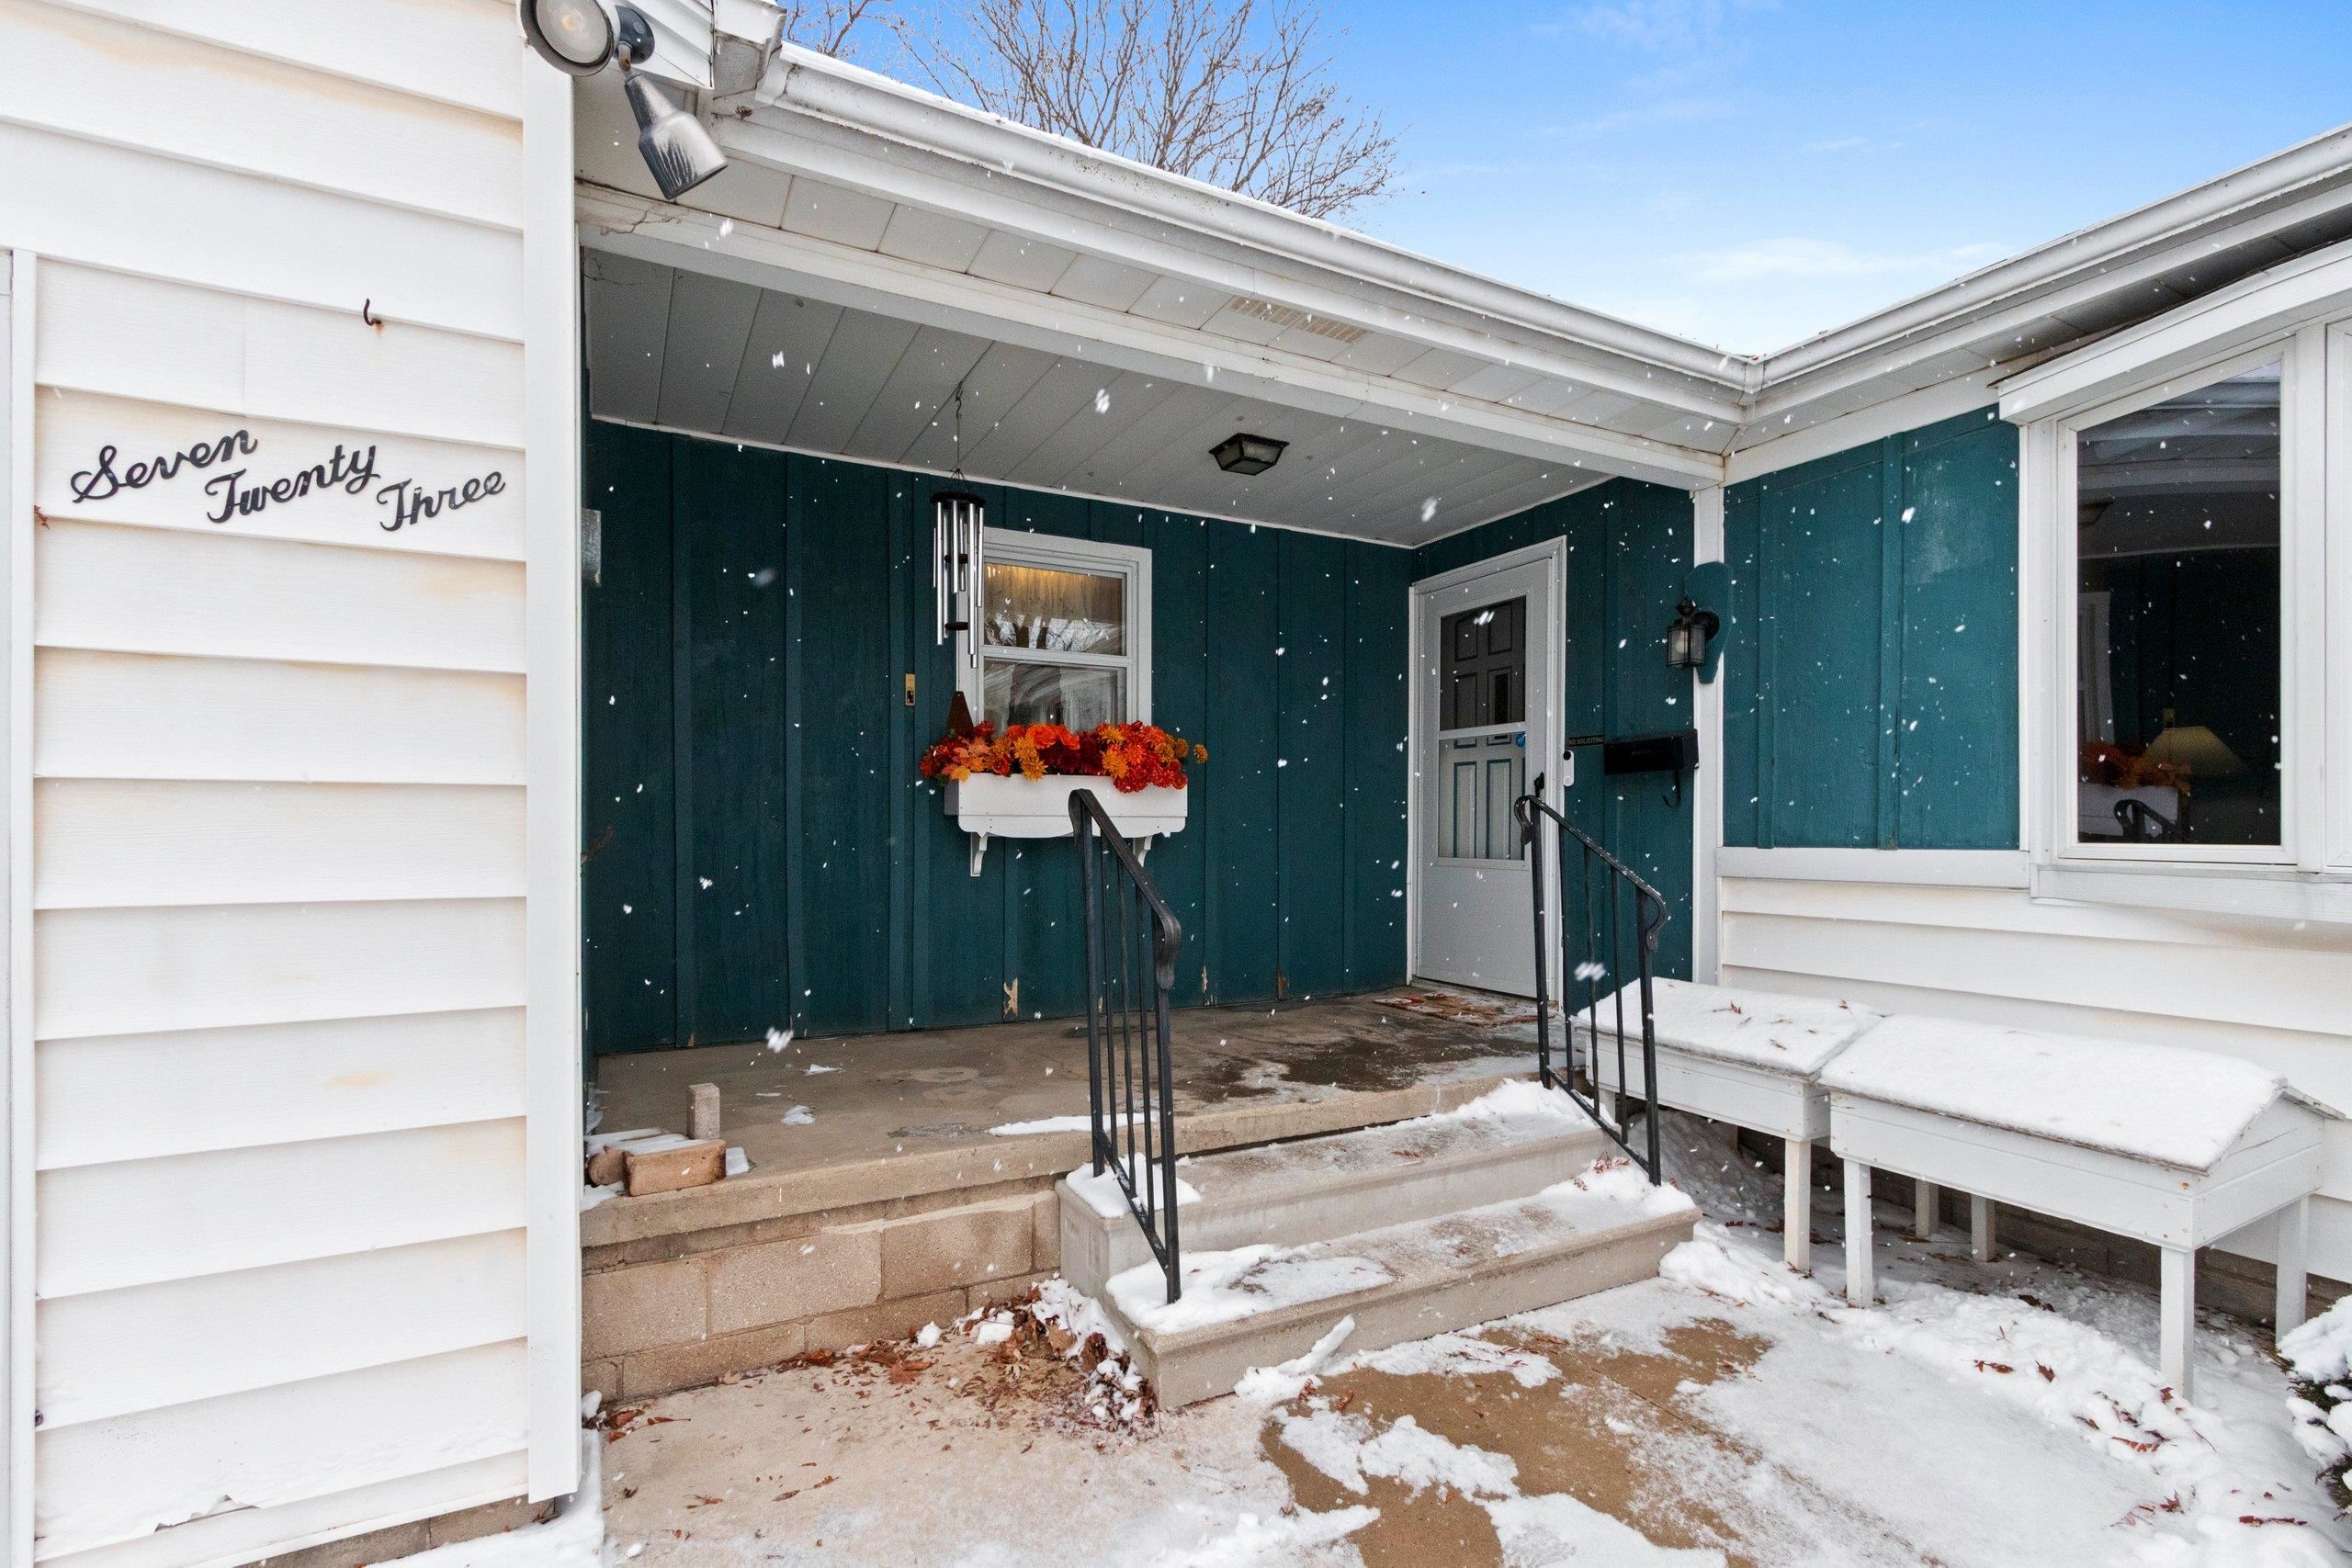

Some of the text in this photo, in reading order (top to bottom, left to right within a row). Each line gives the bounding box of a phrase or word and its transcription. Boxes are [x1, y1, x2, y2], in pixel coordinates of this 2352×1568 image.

[71, 429, 258, 503] Seven
[204, 445, 381, 524] Twenty
[376, 470, 506, 532] Three
